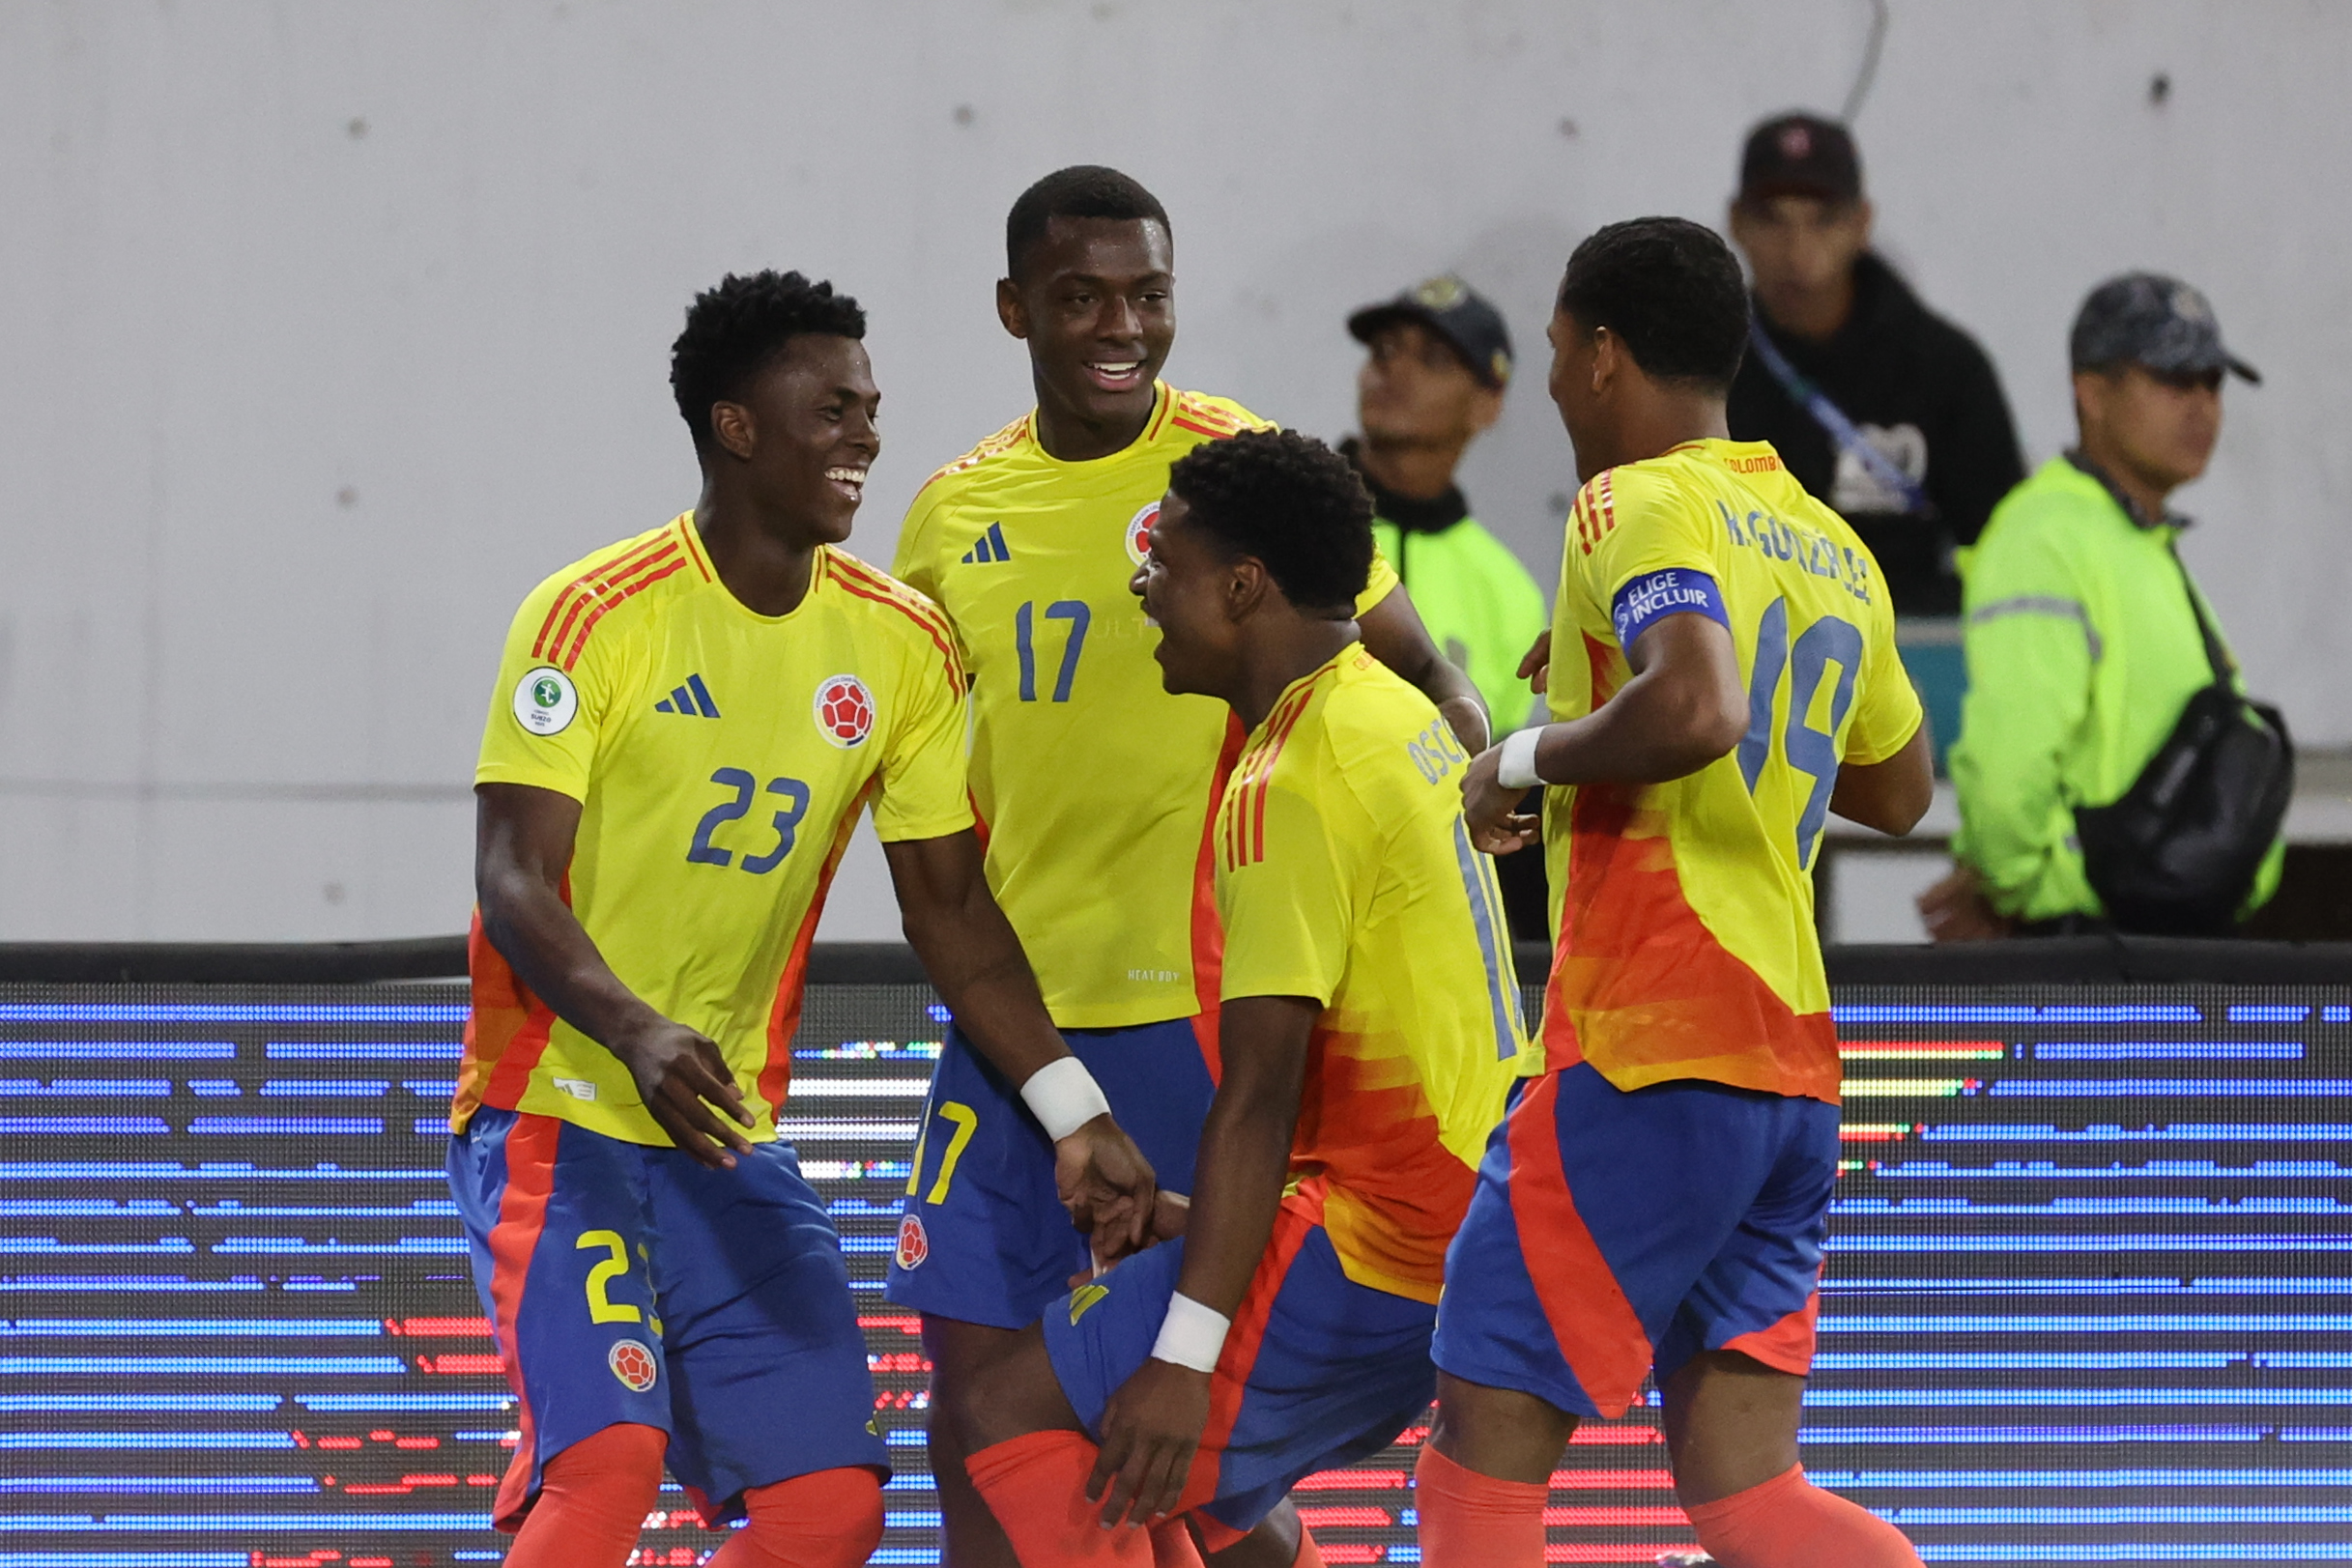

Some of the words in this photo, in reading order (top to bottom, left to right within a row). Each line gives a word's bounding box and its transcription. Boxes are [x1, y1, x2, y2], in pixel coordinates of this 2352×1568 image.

[1628, 572, 1679, 608] ELIGE
[1632, 588, 1709, 624] INCLUIR
[1016, 600, 1091, 702] 17
[1735, 595, 1863, 872] 19
[687, 766, 811, 874] 23
[905, 1099, 978, 1206] 17
[576, 1230, 664, 1339] 2
